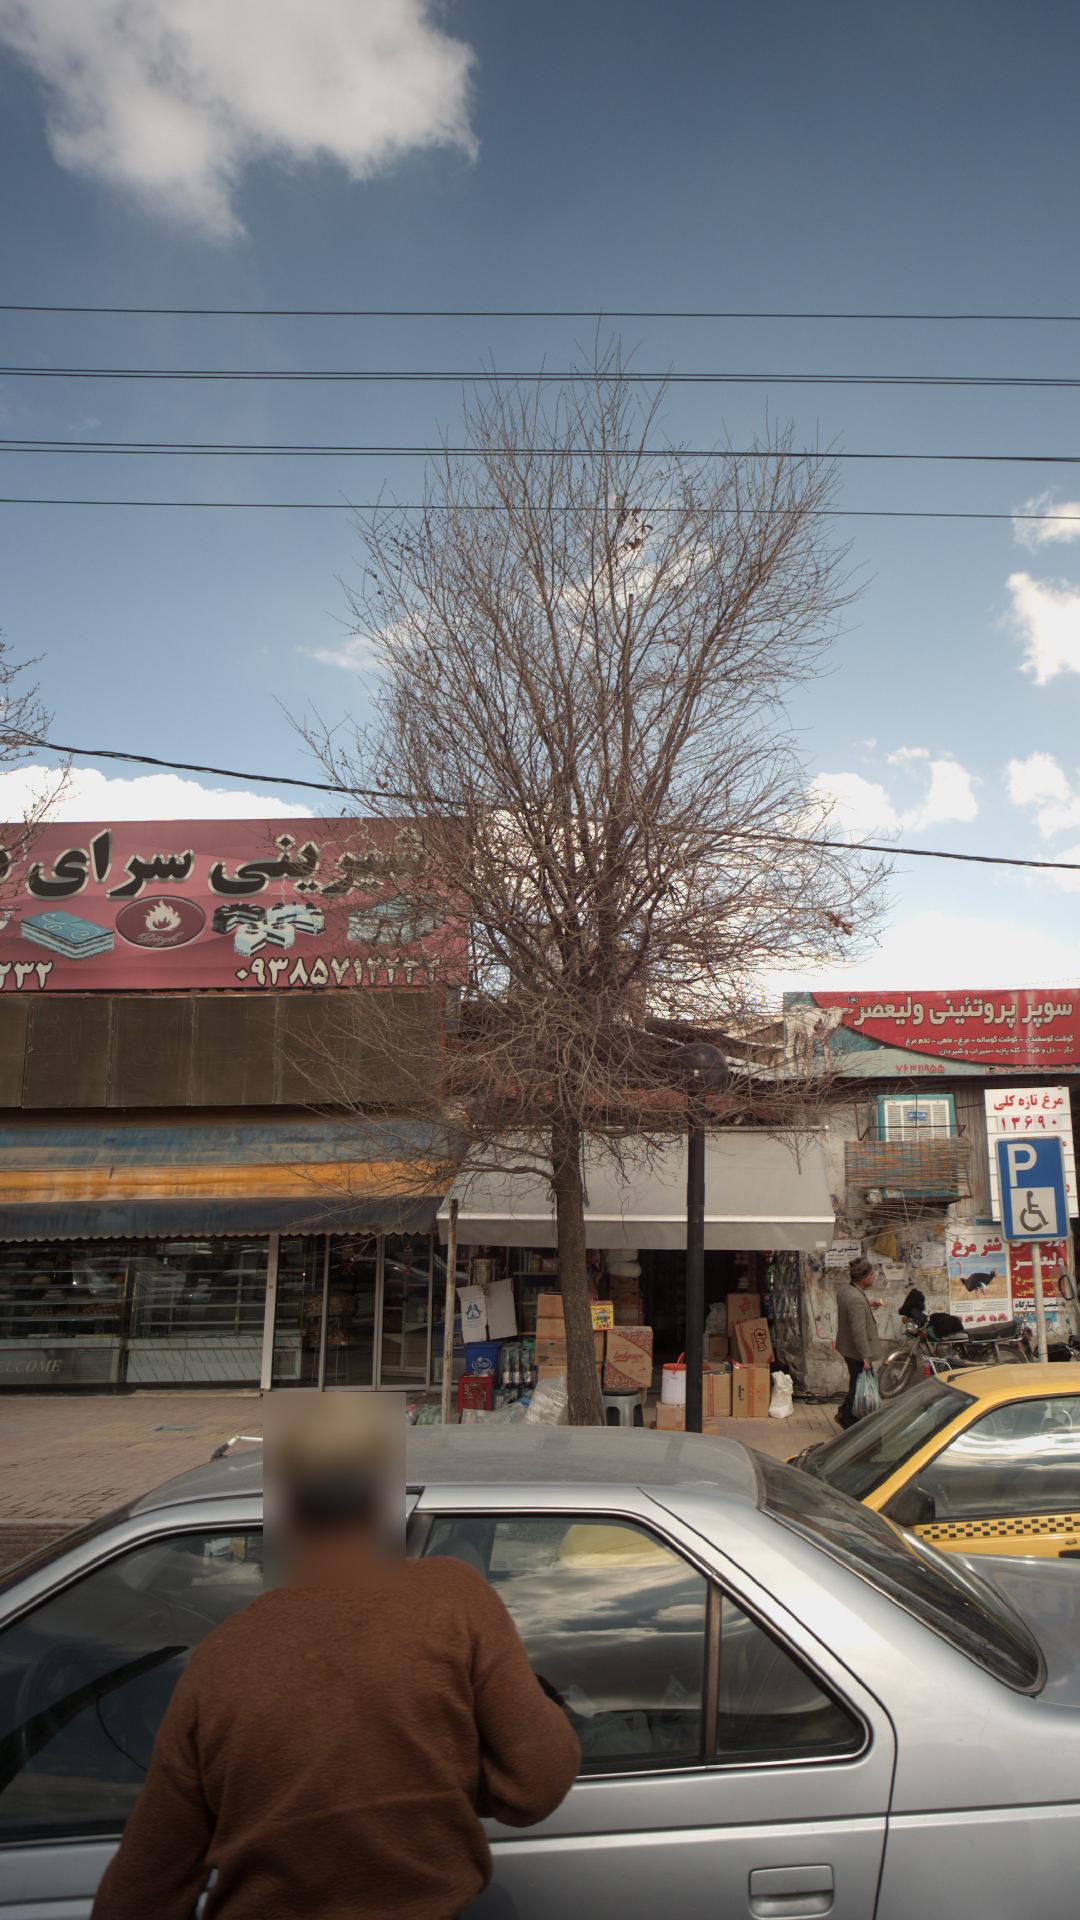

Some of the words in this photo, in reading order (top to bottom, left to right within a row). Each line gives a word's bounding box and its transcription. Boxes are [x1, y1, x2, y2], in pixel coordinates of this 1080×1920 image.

[26, 828, 195, 900] سرای
[853, 996, 925, 1026] ولیعصر
[928, 996, 1018, 1029] پروتئینی
[1021, 1001, 1074, 1028] سوپر
[993, 1094, 1016, 1111] کلی
[1018, 1093, 1038, 1110] تازه
[1042, 1092, 1064, 1109] مرغ
[1007, 1143, 1037, 1187] P
[951, 1239, 977, 1258] مرغ
[980, 1237, 1003, 1257] شتر
